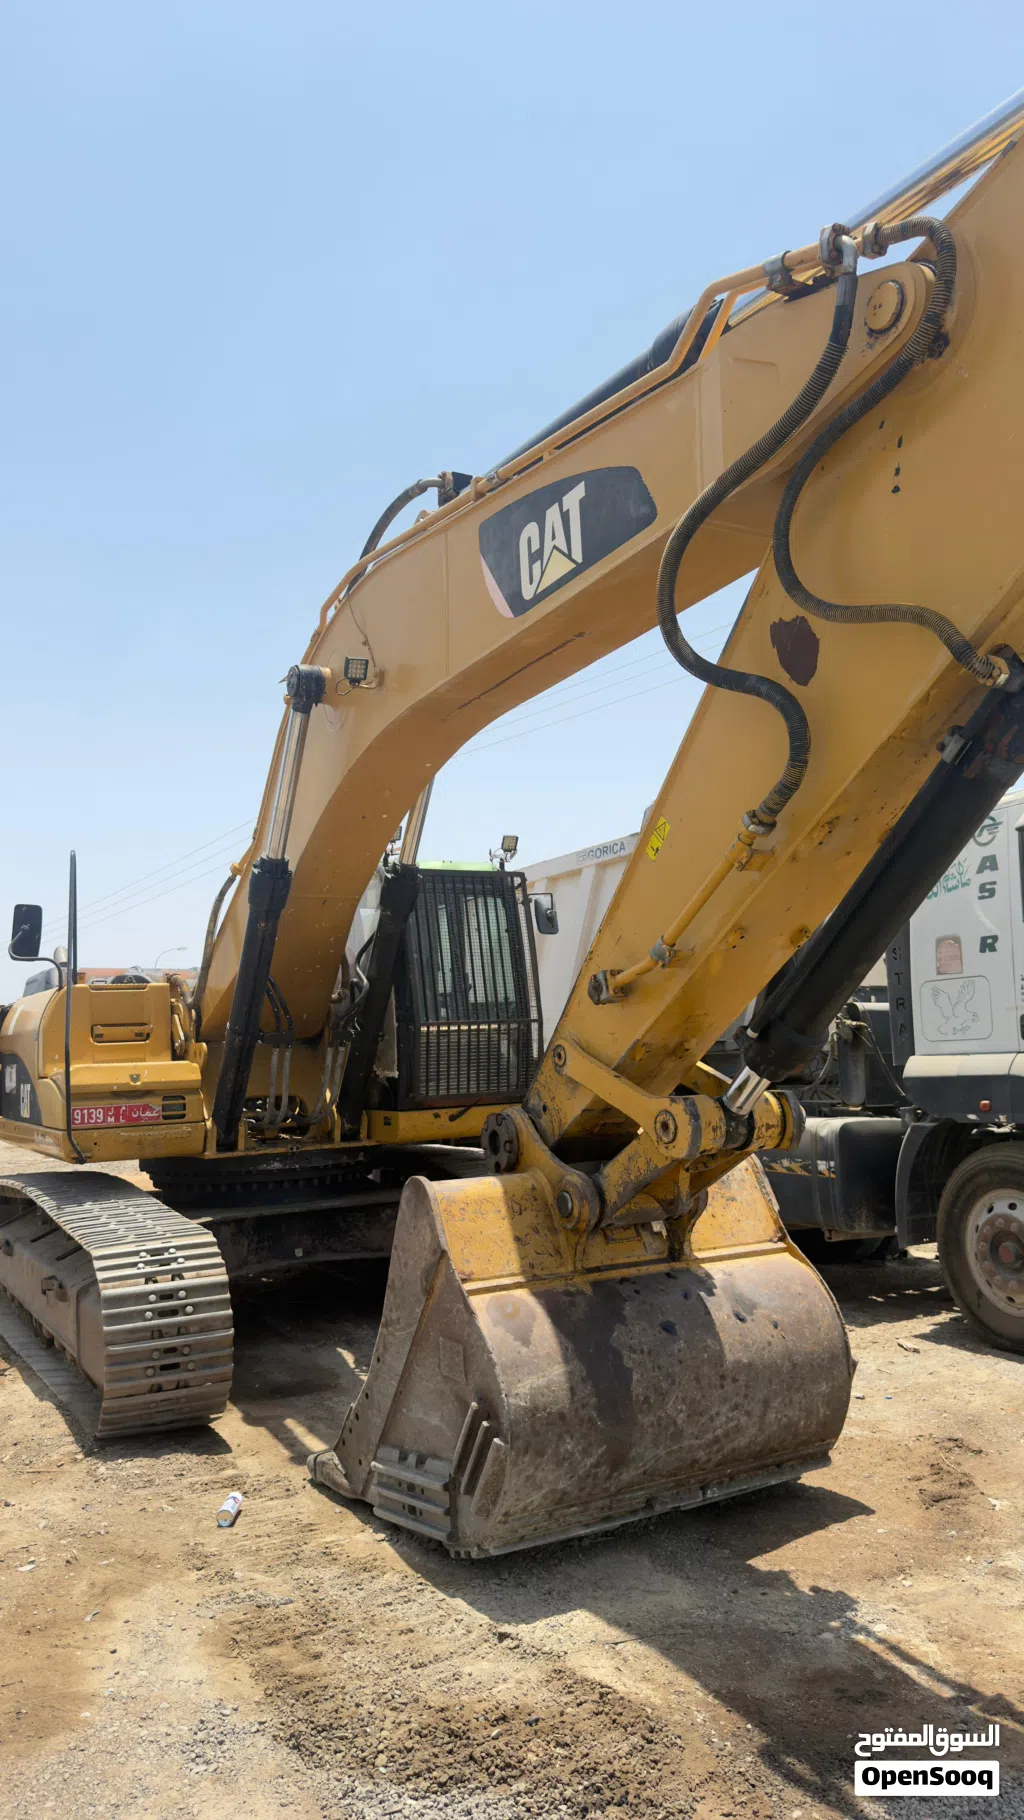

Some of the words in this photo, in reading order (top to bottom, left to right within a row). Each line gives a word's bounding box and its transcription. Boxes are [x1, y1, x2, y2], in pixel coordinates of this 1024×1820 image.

[519, 480, 586, 600] CAT
[587, 841, 626, 860] GORICA
[20, 1083, 31, 1119] CAT
[74, 1108, 104, 1124] 9139
